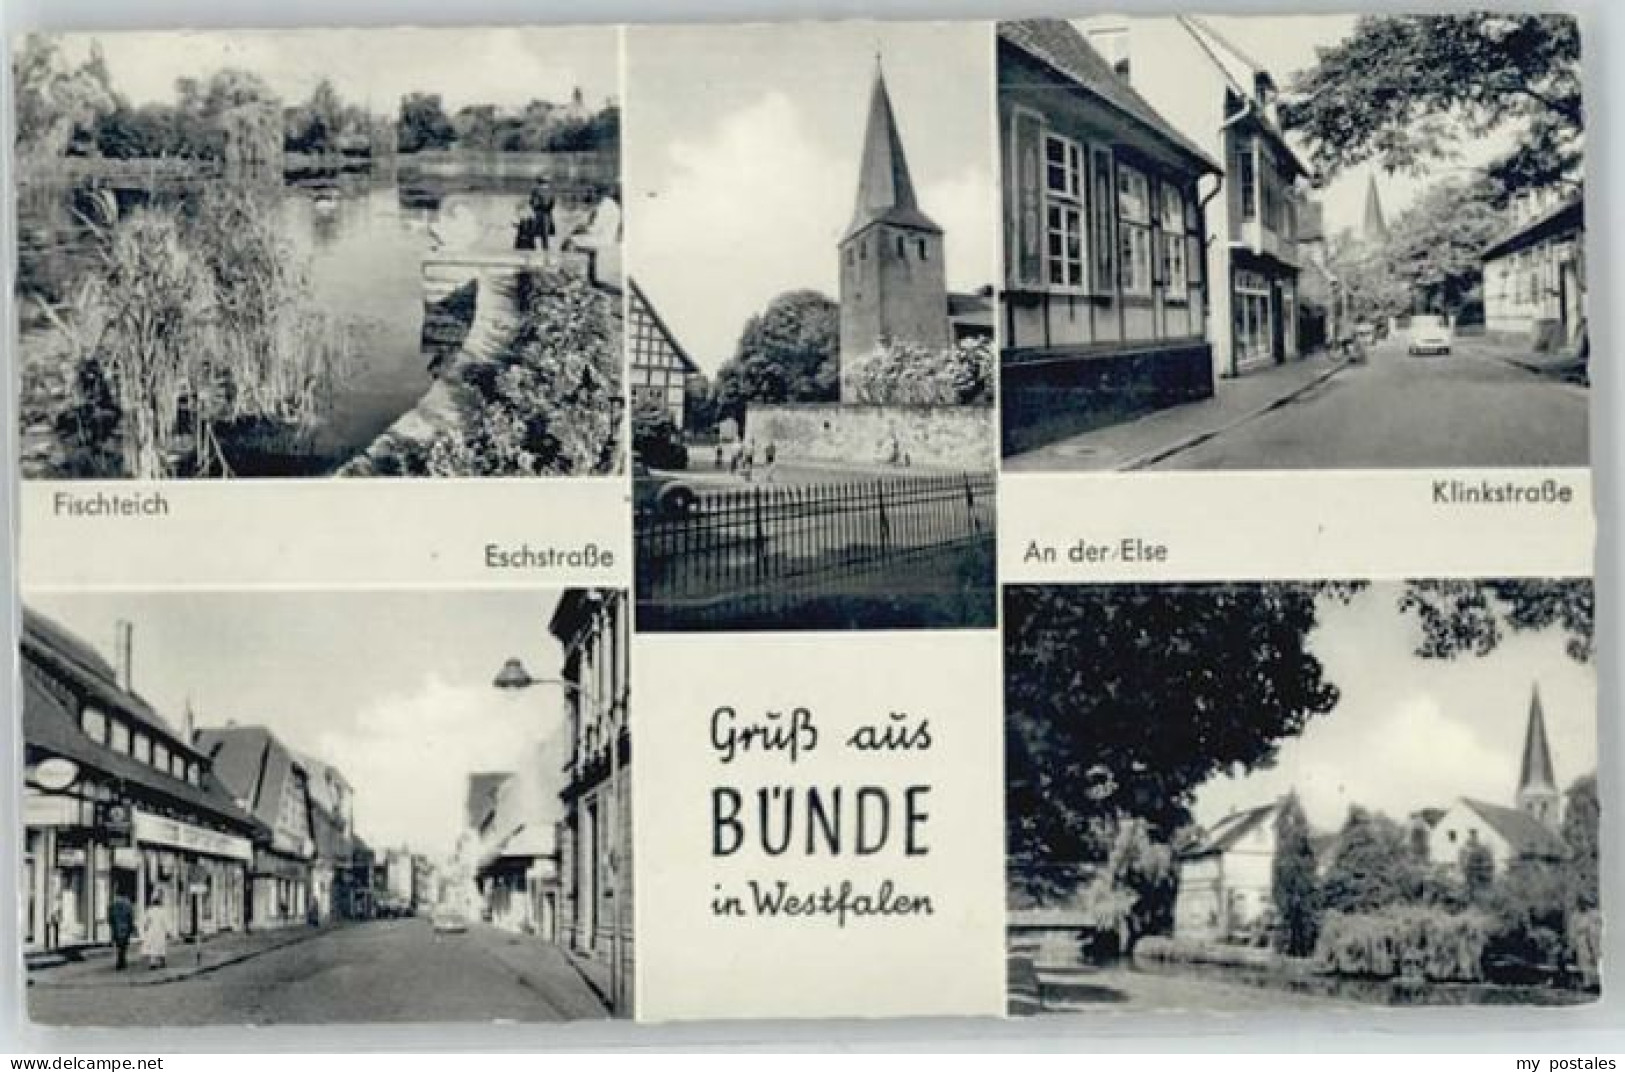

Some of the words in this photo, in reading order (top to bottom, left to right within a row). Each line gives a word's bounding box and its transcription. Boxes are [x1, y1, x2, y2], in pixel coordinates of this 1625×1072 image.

[53, 491, 169, 516] Fischteich
[1432, 480, 1573, 504] Klinkstraße
[484, 544, 615, 568] Eschstraße
[1024, 539, 1057, 563] An
[1068, 538, 1110, 563] der
[1120, 538, 1168, 562] Else
[711, 785, 931, 857] BÜNDE
[711, 884, 746, 916] in
[747, 880, 934, 928] Westfalen
